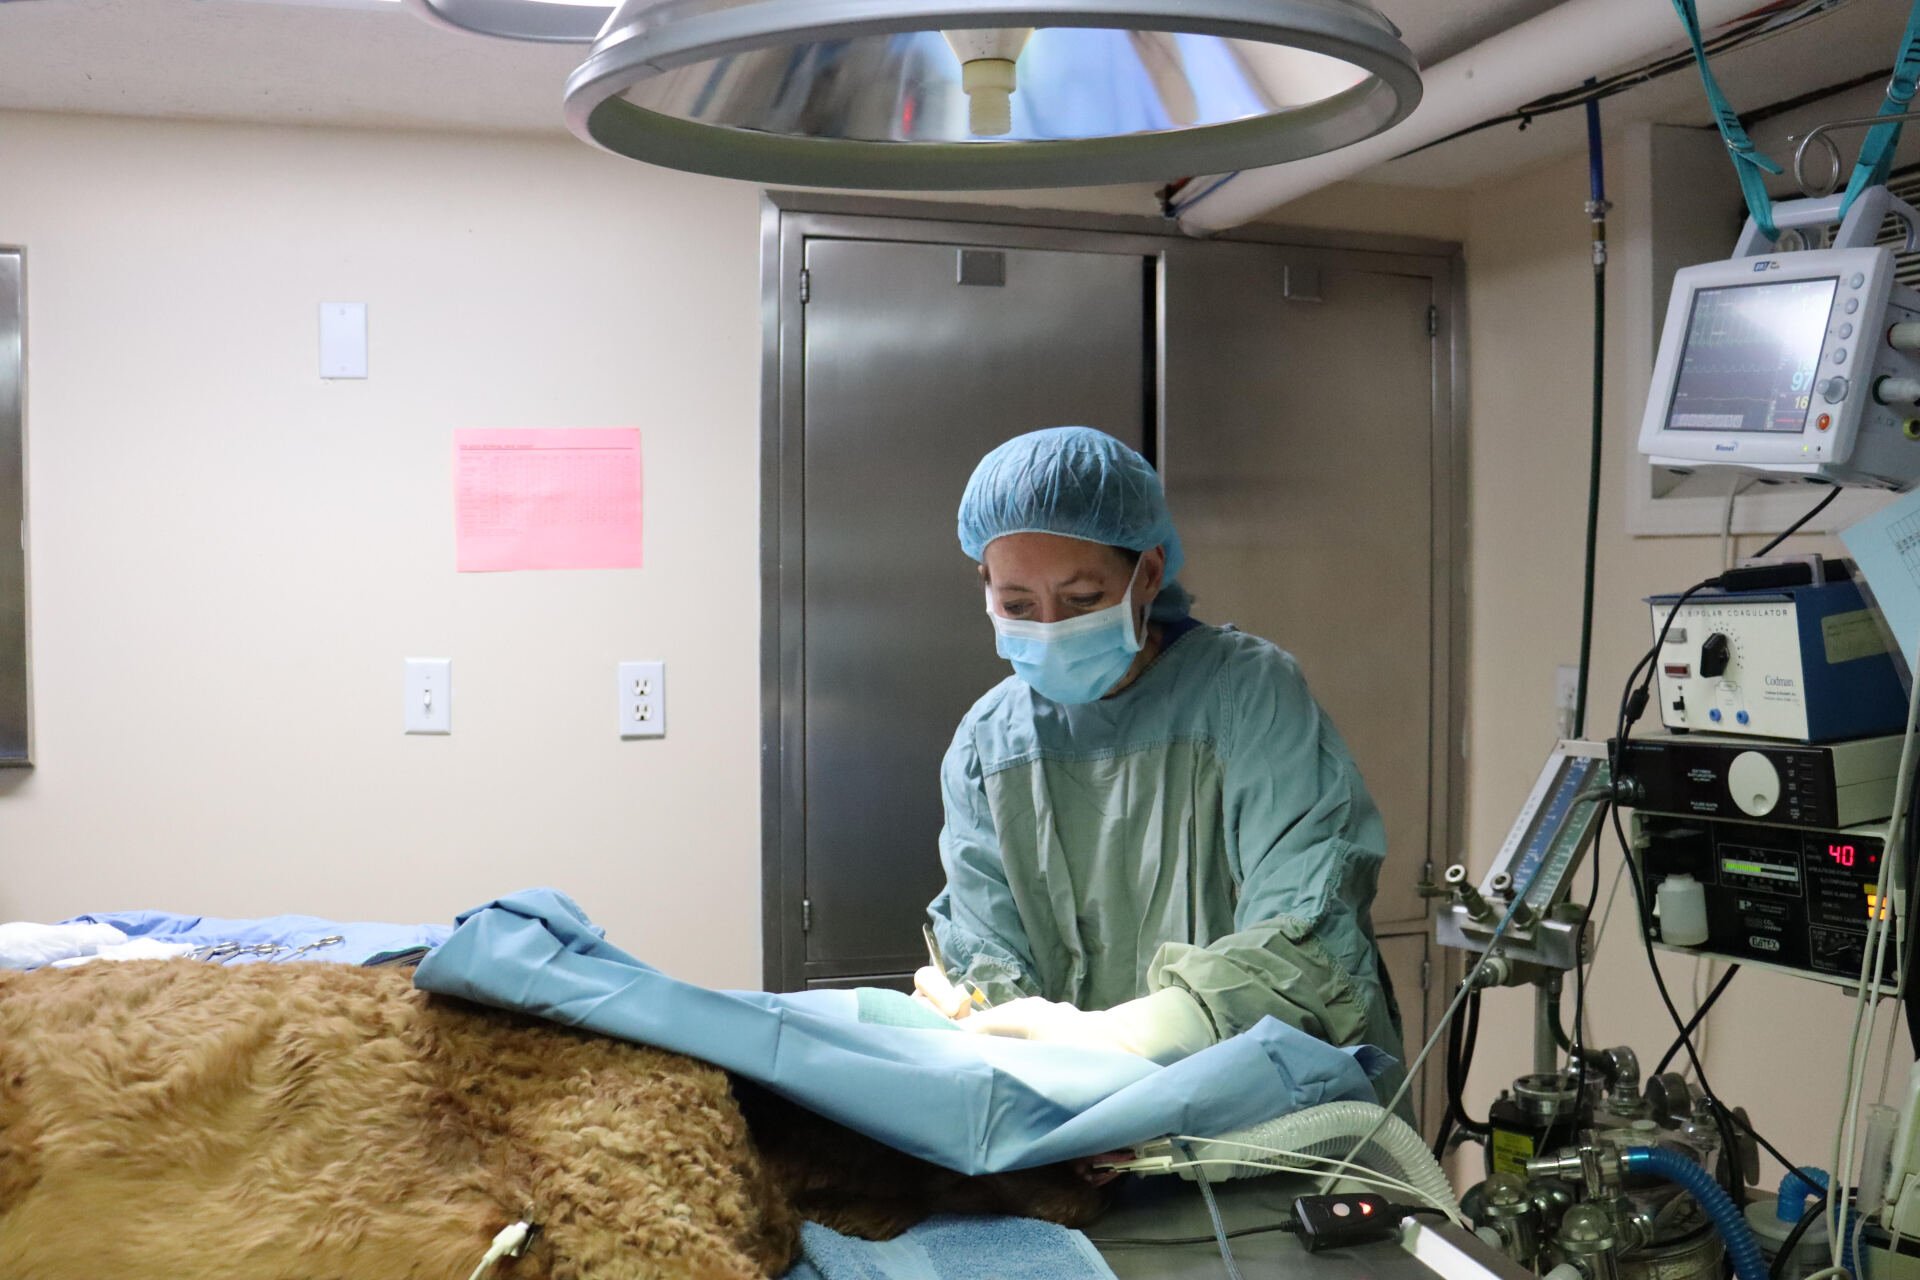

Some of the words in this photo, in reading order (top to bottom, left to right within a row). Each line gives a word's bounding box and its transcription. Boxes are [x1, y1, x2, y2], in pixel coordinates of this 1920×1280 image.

[1792, 372, 1813, 391] 97
[1795, 396, 1809, 409] 16
[1688, 609, 1722, 617] BIPOLAR
[1727, 609, 1788, 617] COAGULATOR
[1765, 675, 1794, 687] Codman
[1828, 844, 1855, 867] 40
